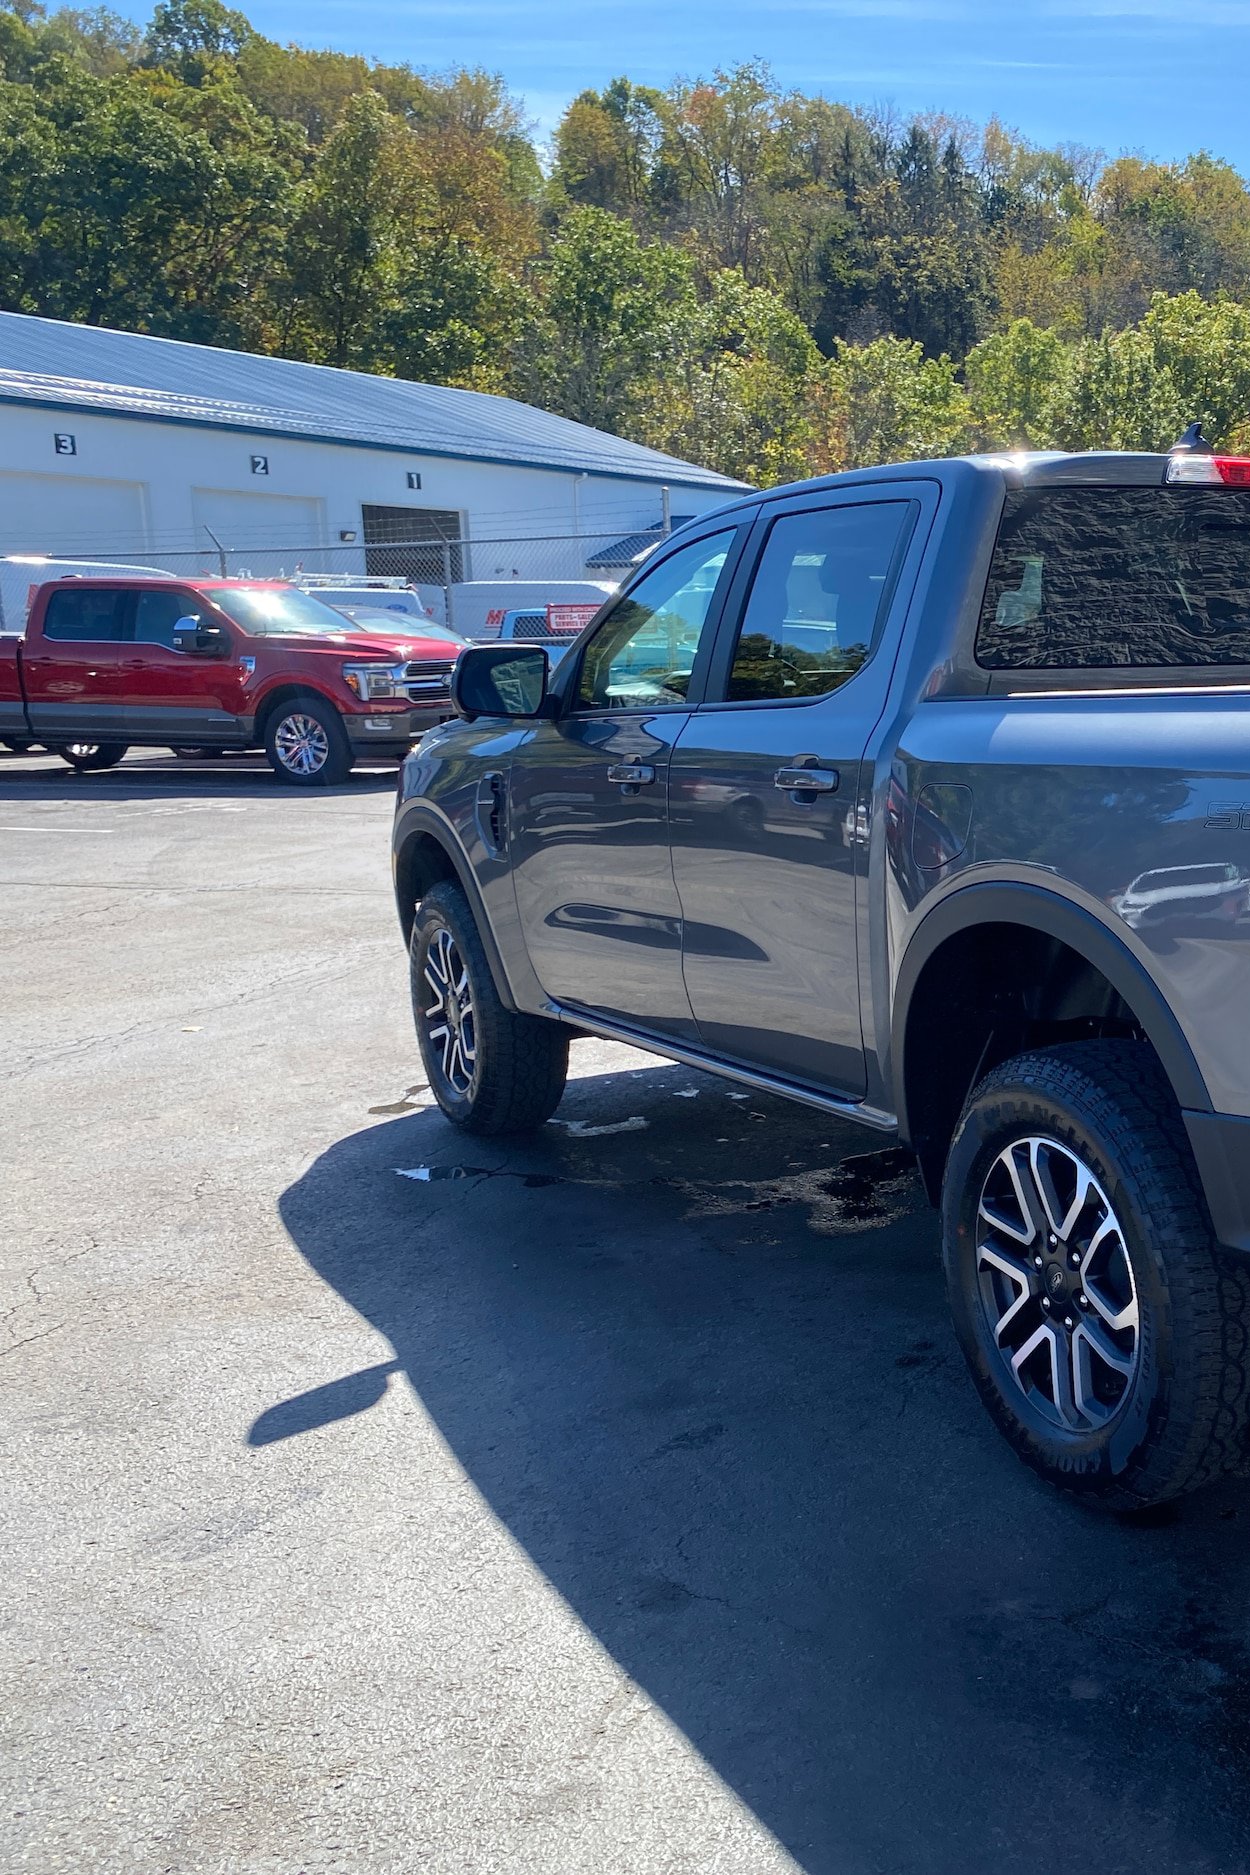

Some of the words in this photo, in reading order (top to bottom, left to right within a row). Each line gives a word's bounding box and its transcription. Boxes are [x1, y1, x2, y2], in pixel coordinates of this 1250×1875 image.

[57, 434, 75, 455] 3
[253, 456, 267, 474] 2
[410, 473, 418, 489] 1
